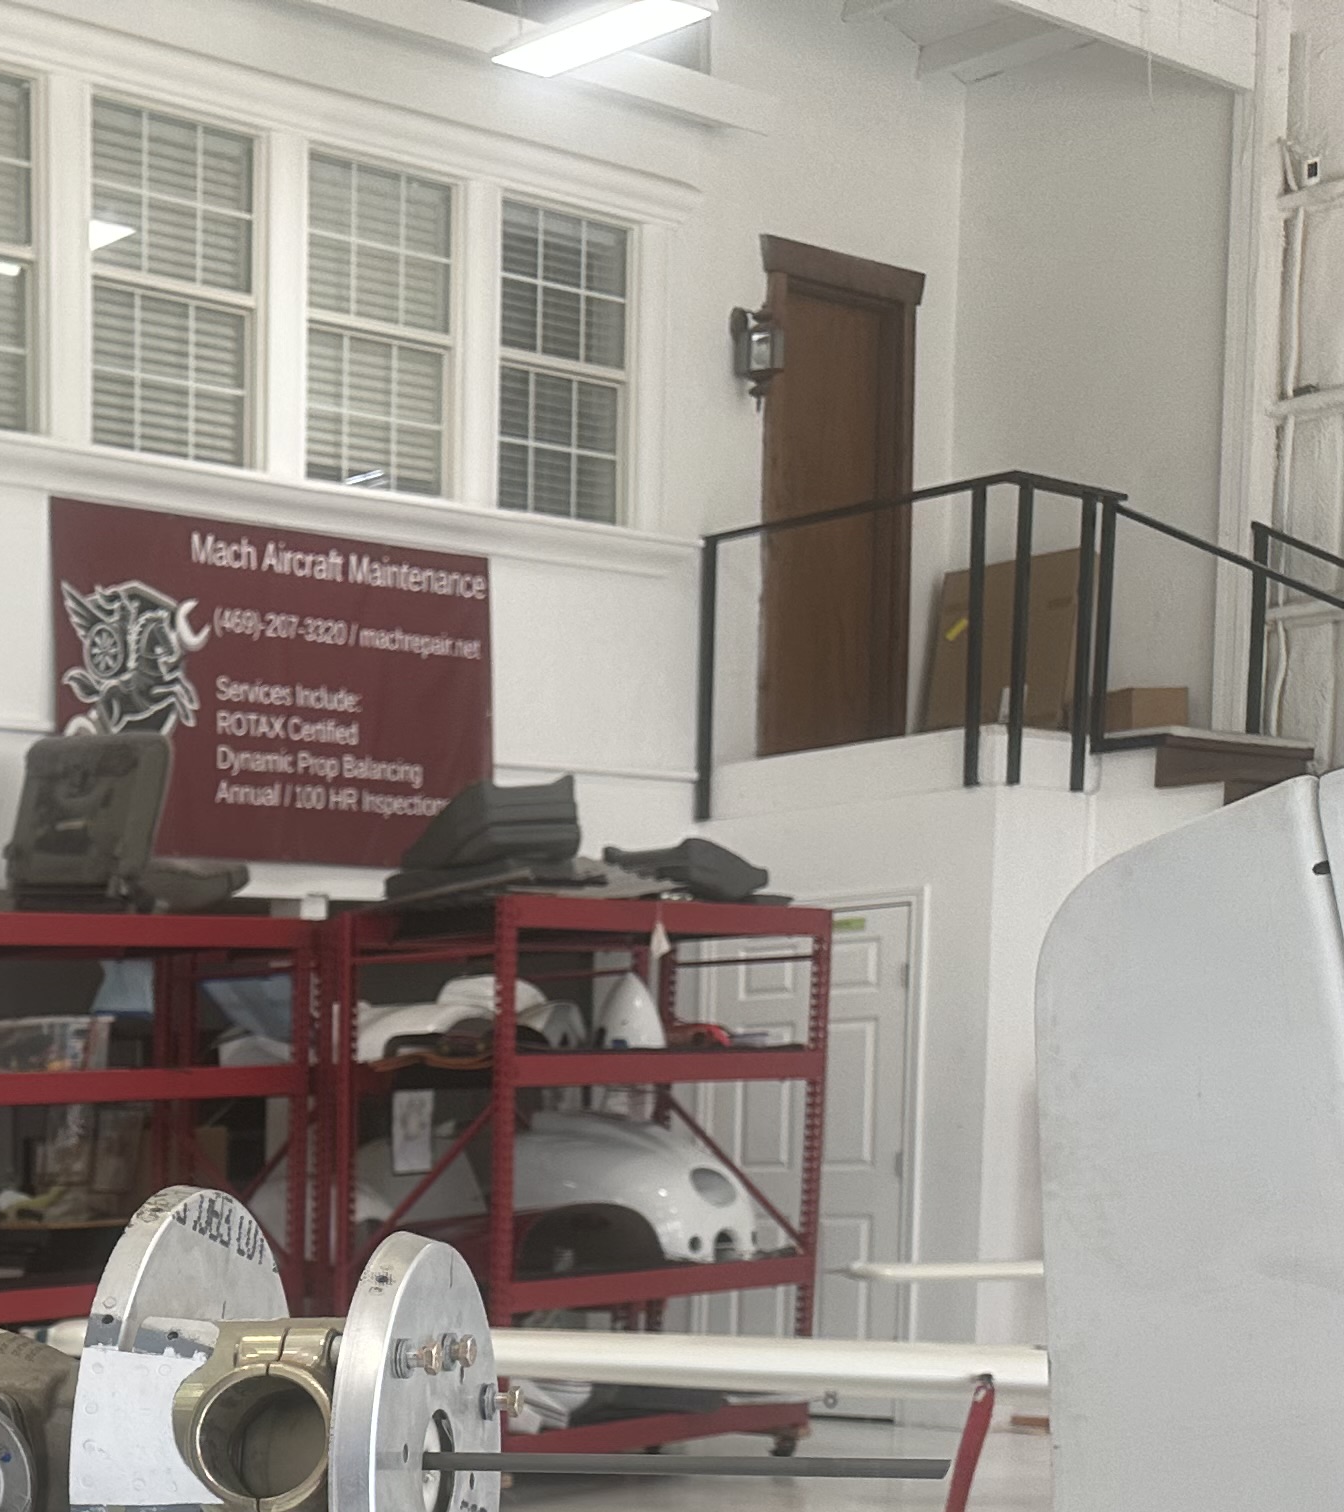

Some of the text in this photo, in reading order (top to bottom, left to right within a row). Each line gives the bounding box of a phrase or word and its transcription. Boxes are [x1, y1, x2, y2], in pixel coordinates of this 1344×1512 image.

[191, 531, 487, 600] Mach Aircraft Maintenance
[214, 606, 349, 646] (469)-207-3320
[360, 625, 481, 659] machrepair.net
[216, 675, 362, 713] Services Include:
[216, 709, 360, 746] ROTAX Certified
[216, 744, 424, 789] Dynamic Prop Balancing
[215, 779, 282, 807] Annual
[295, 784, 327, 810] 100
[328, 787, 359, 811] HR
